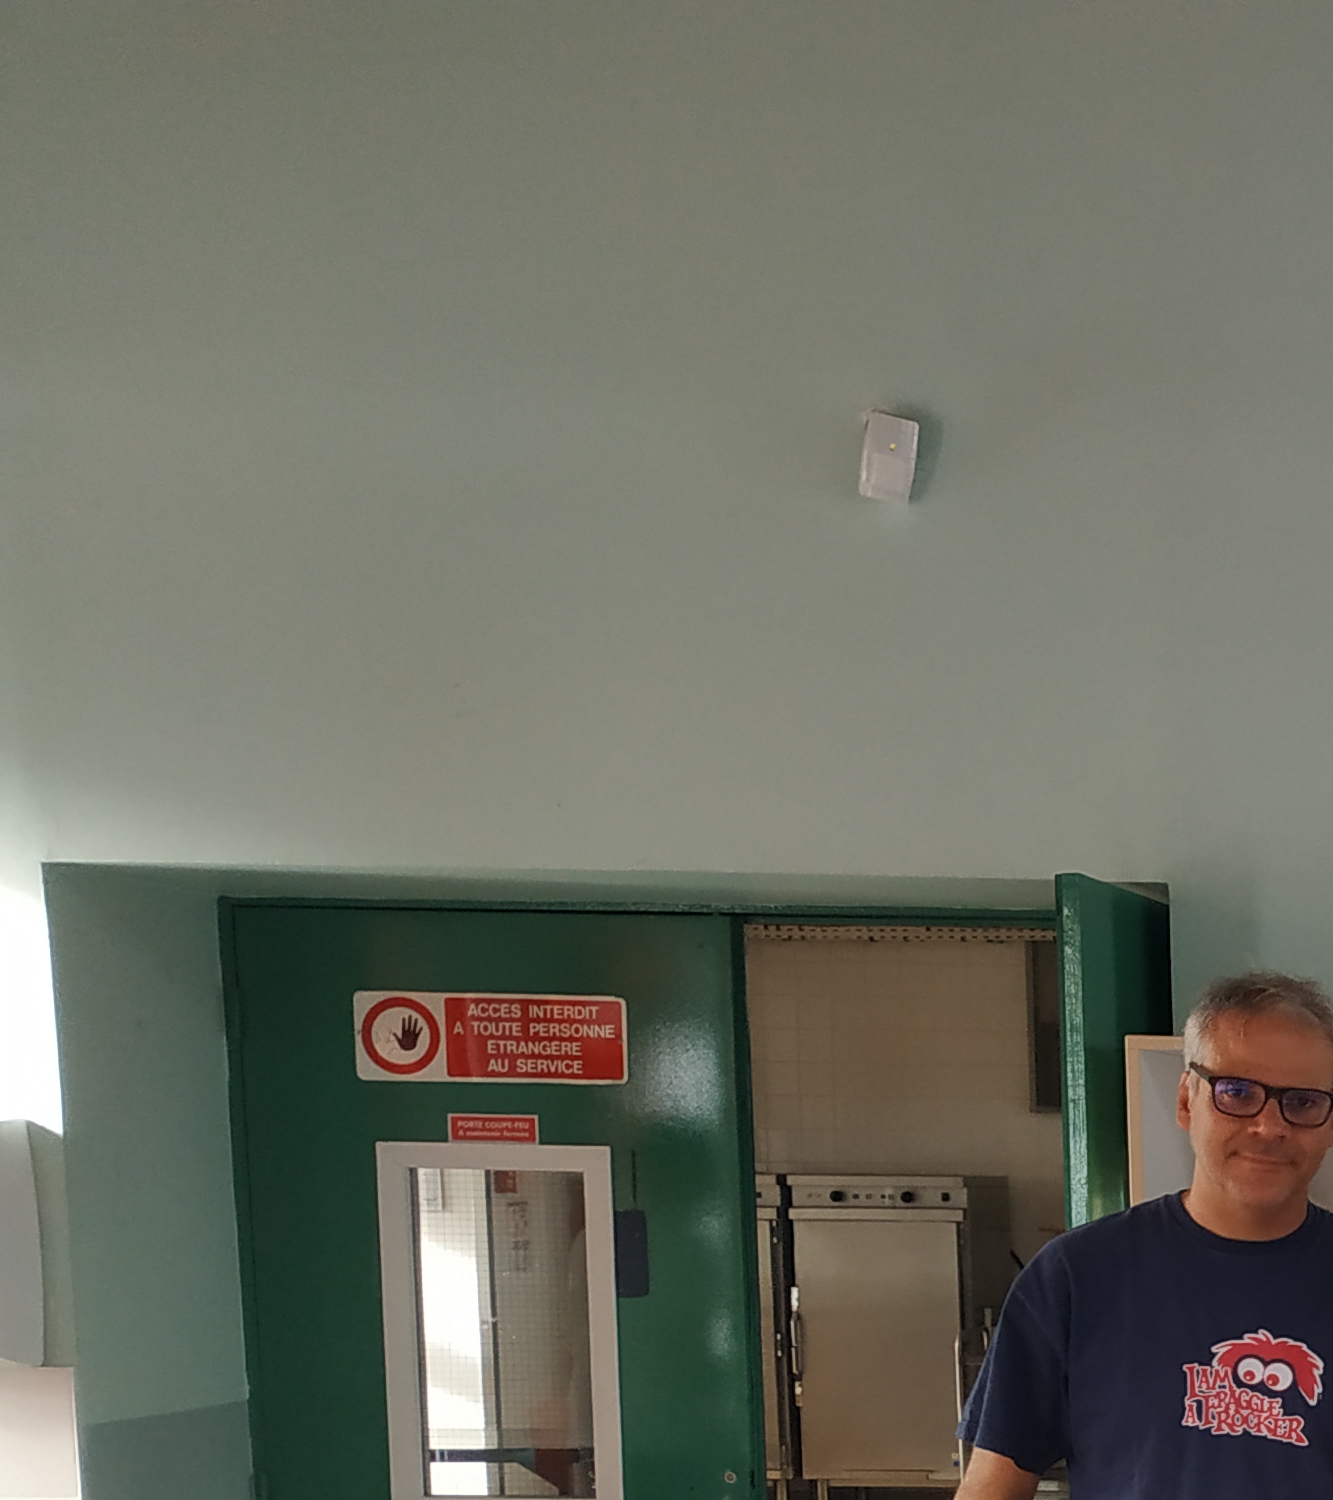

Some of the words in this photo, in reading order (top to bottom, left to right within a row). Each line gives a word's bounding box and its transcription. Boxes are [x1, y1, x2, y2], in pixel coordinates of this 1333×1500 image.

[467, 1003, 522, 1018] ACCES
[528, 1004, 599, 1020] INTERDIT
[453, 1021, 464, 1035] A
[471, 1021, 523, 1036] TOUTE
[529, 1022, 616, 1039] PERSONNE
[487, 1040, 583, 1056] ETRANGERE
[487, 1059, 509, 1072] AU
[516, 1059, 584, 1074] SERVICE
[1183, 1364, 1201, 1401] I
[1197, 1366, 1234, 1392] AM
[1182, 1402, 1198, 1425] A
[1199, 1389, 1283, 1428] FRAGGLE
[1212, 1408, 1309, 1446] ROCKER
